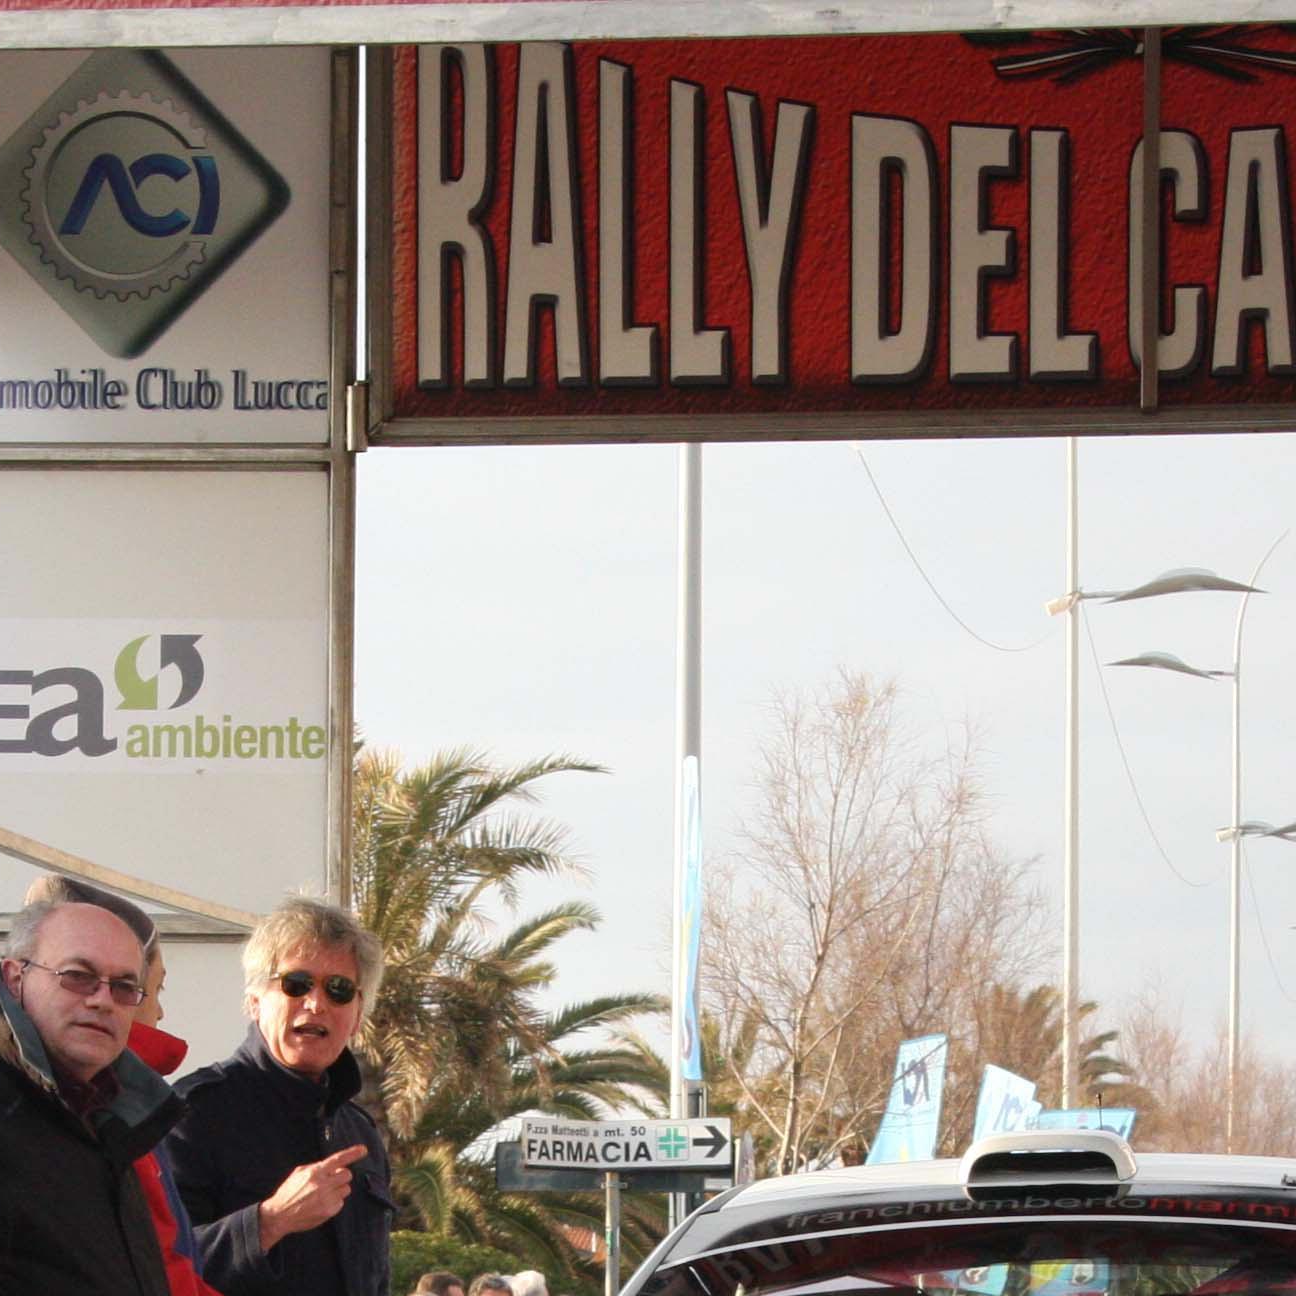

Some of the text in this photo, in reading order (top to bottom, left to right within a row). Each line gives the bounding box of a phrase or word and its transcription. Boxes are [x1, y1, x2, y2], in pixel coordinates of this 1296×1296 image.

[60, 152, 221, 238] ACI
[417, 43, 816, 388] RALLY
[850, 112, 1097, 386] DEL
[136, 367, 221, 410] Club
[232, 370, 328, 411] Lucca
[125, 714, 326, 760] ambiente
[526, 1139, 653, 1163] FARMACIA
[630, 1126, 647, 1137] 50
